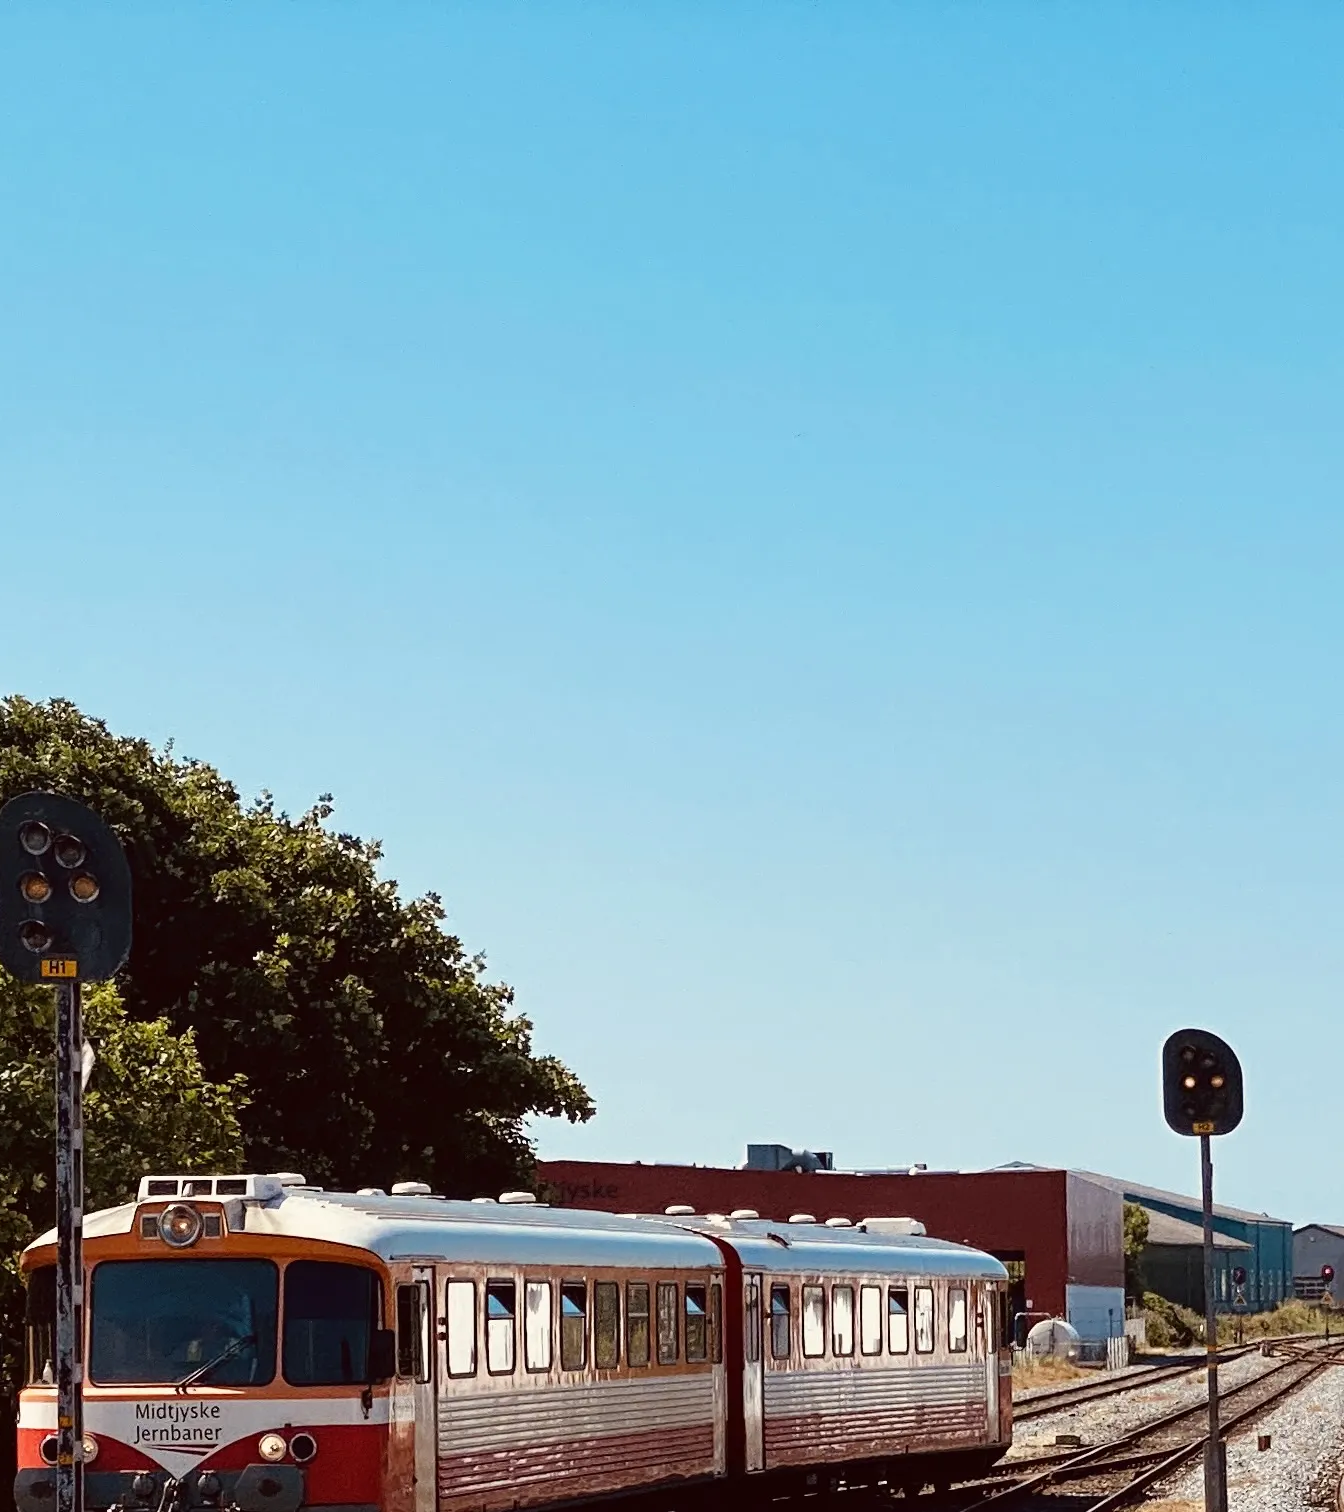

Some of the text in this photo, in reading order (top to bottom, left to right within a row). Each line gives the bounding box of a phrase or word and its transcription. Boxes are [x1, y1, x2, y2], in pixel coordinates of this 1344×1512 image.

[49, 960, 67, 975] H1
[135, 1402, 221, 1423] Midtjyske
[133, 1424, 223, 1445] Jernbaner
